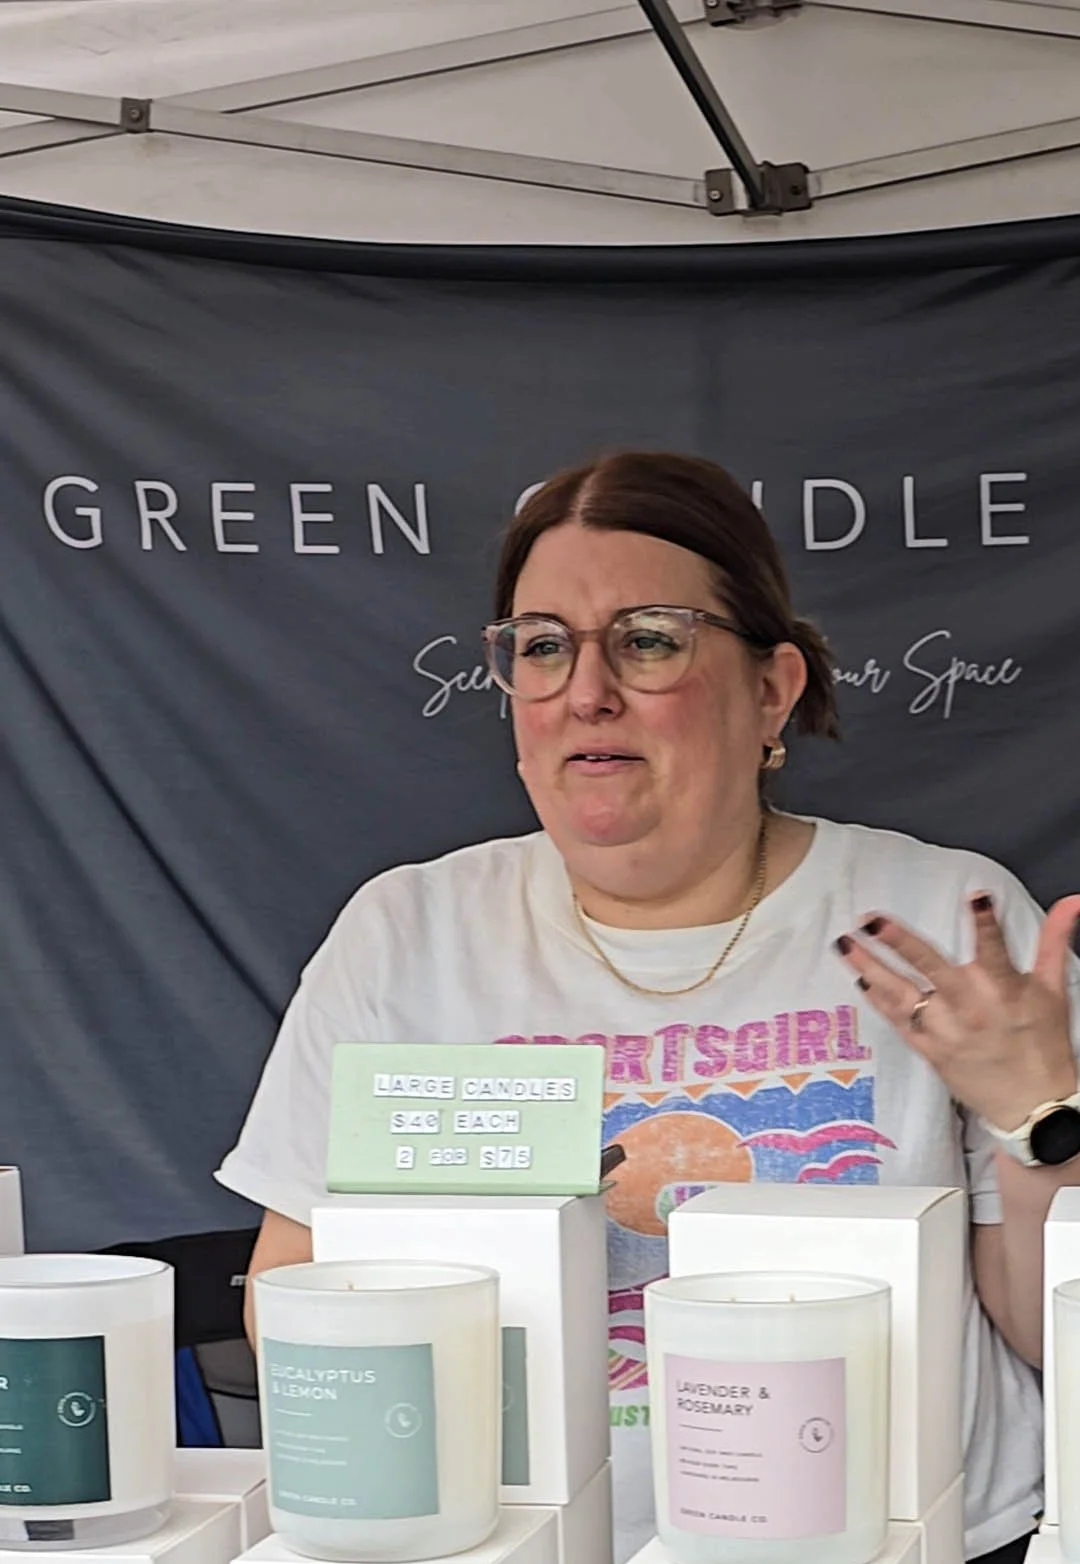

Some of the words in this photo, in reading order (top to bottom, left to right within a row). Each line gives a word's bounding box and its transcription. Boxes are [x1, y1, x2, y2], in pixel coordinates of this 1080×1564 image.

[42, 475, 431, 554] GREEN
[903, 630, 1022, 719] Space
[494, 1005, 872, 1084] RTSGIRL
[375, 1077, 455, 1096] LARGE
[462, 1080, 575, 1098] CANDLES
[392, 1112, 440, 1130] $40
[456, 1113, 518, 1131] EACH
[398, 1149, 411, 1165] 2
[430, 1150, 467, 1164] FOR
[481, 1149, 531, 1167] $75
[269, 1362, 376, 1385] EUCALYPTUS
[281, 1383, 338, 1401] LEMON
[675, 1380, 751, 1400] LAVENDER
[757, 1386, 771, 1400] &
[676, 1397, 753, 1417] ROSEMARY
